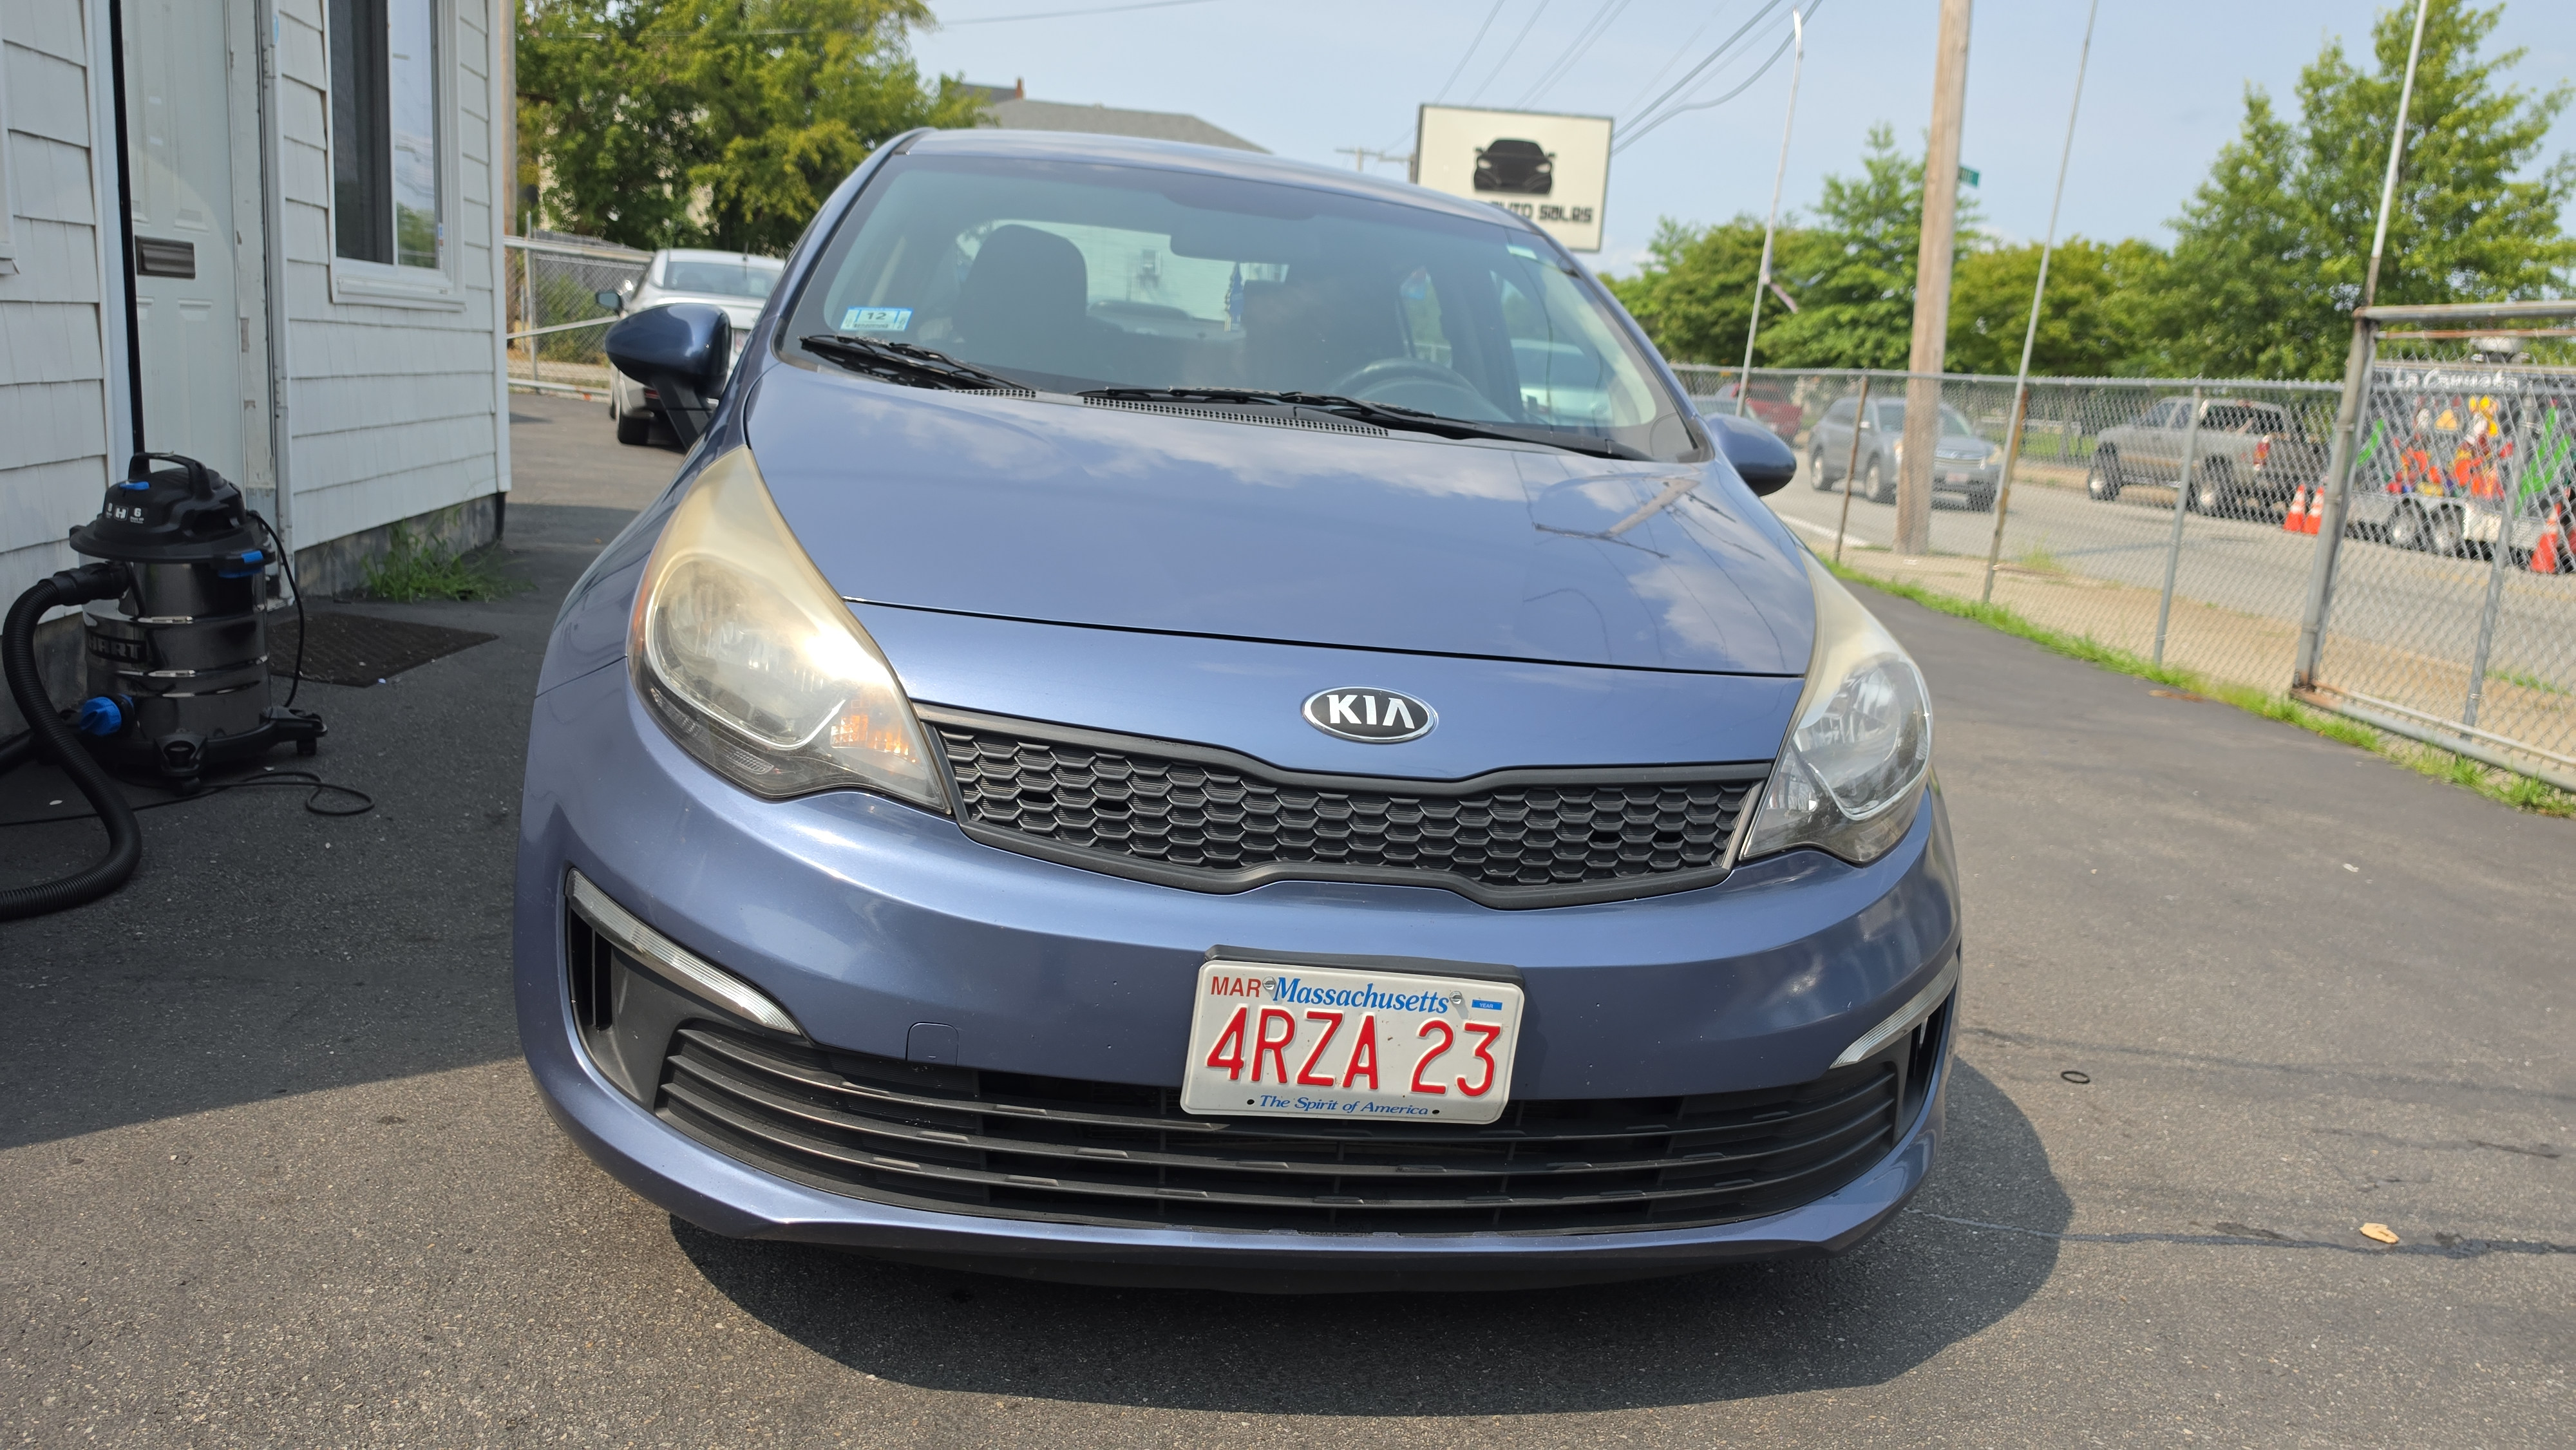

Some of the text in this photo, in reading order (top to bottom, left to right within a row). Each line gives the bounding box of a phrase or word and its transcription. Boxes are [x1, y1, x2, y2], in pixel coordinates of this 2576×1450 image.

[1490, 201, 1533, 219] TO
[867, 312, 887, 320] 12
[115, 507, 127, 519] H
[87, 633, 142, 658] HART
[1327, 694, 1415, 729] KIA
[1211, 976, 1260, 997] MAR
[1273, 977, 1448, 1014] Massachusetts
[1207, 1006, 1501, 1097] 4RZA 23
[1260, 1095, 1428, 1115] The Spirit of America
